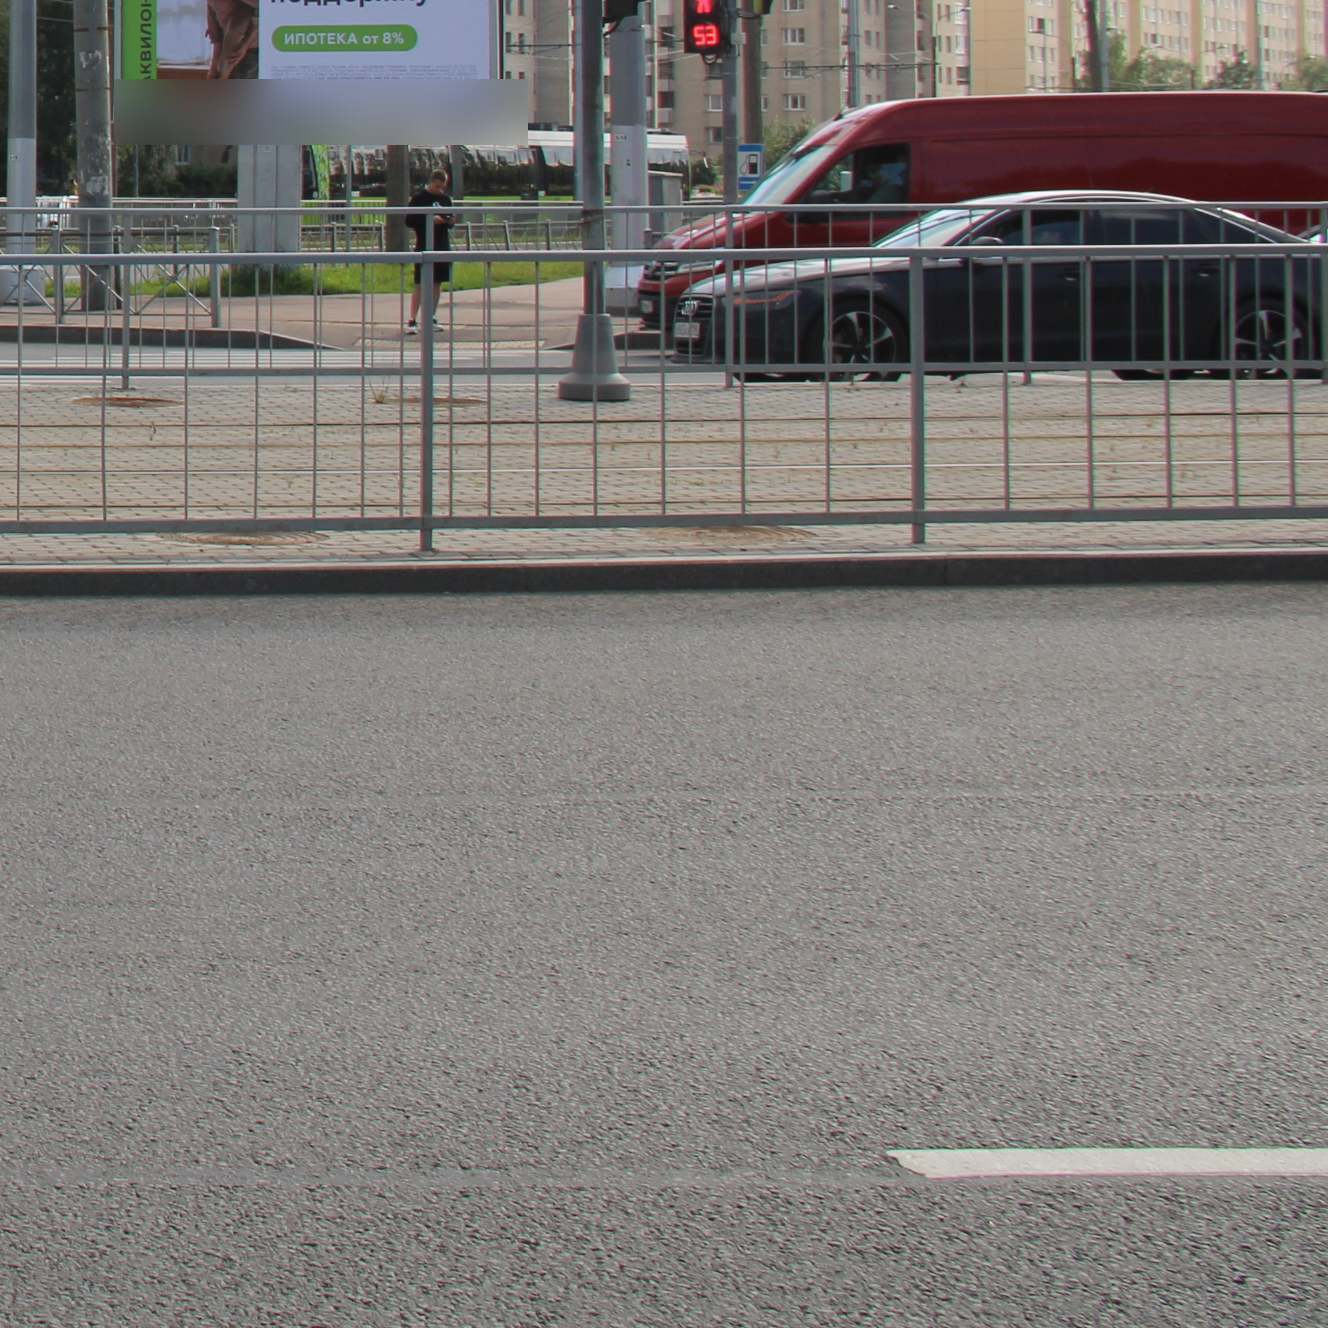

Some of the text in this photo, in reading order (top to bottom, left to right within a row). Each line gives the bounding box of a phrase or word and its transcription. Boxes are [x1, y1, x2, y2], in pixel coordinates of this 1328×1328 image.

[284, 32, 405, 45] ИПОТЕКА от 8%
[693, 24, 717, 46] 53
